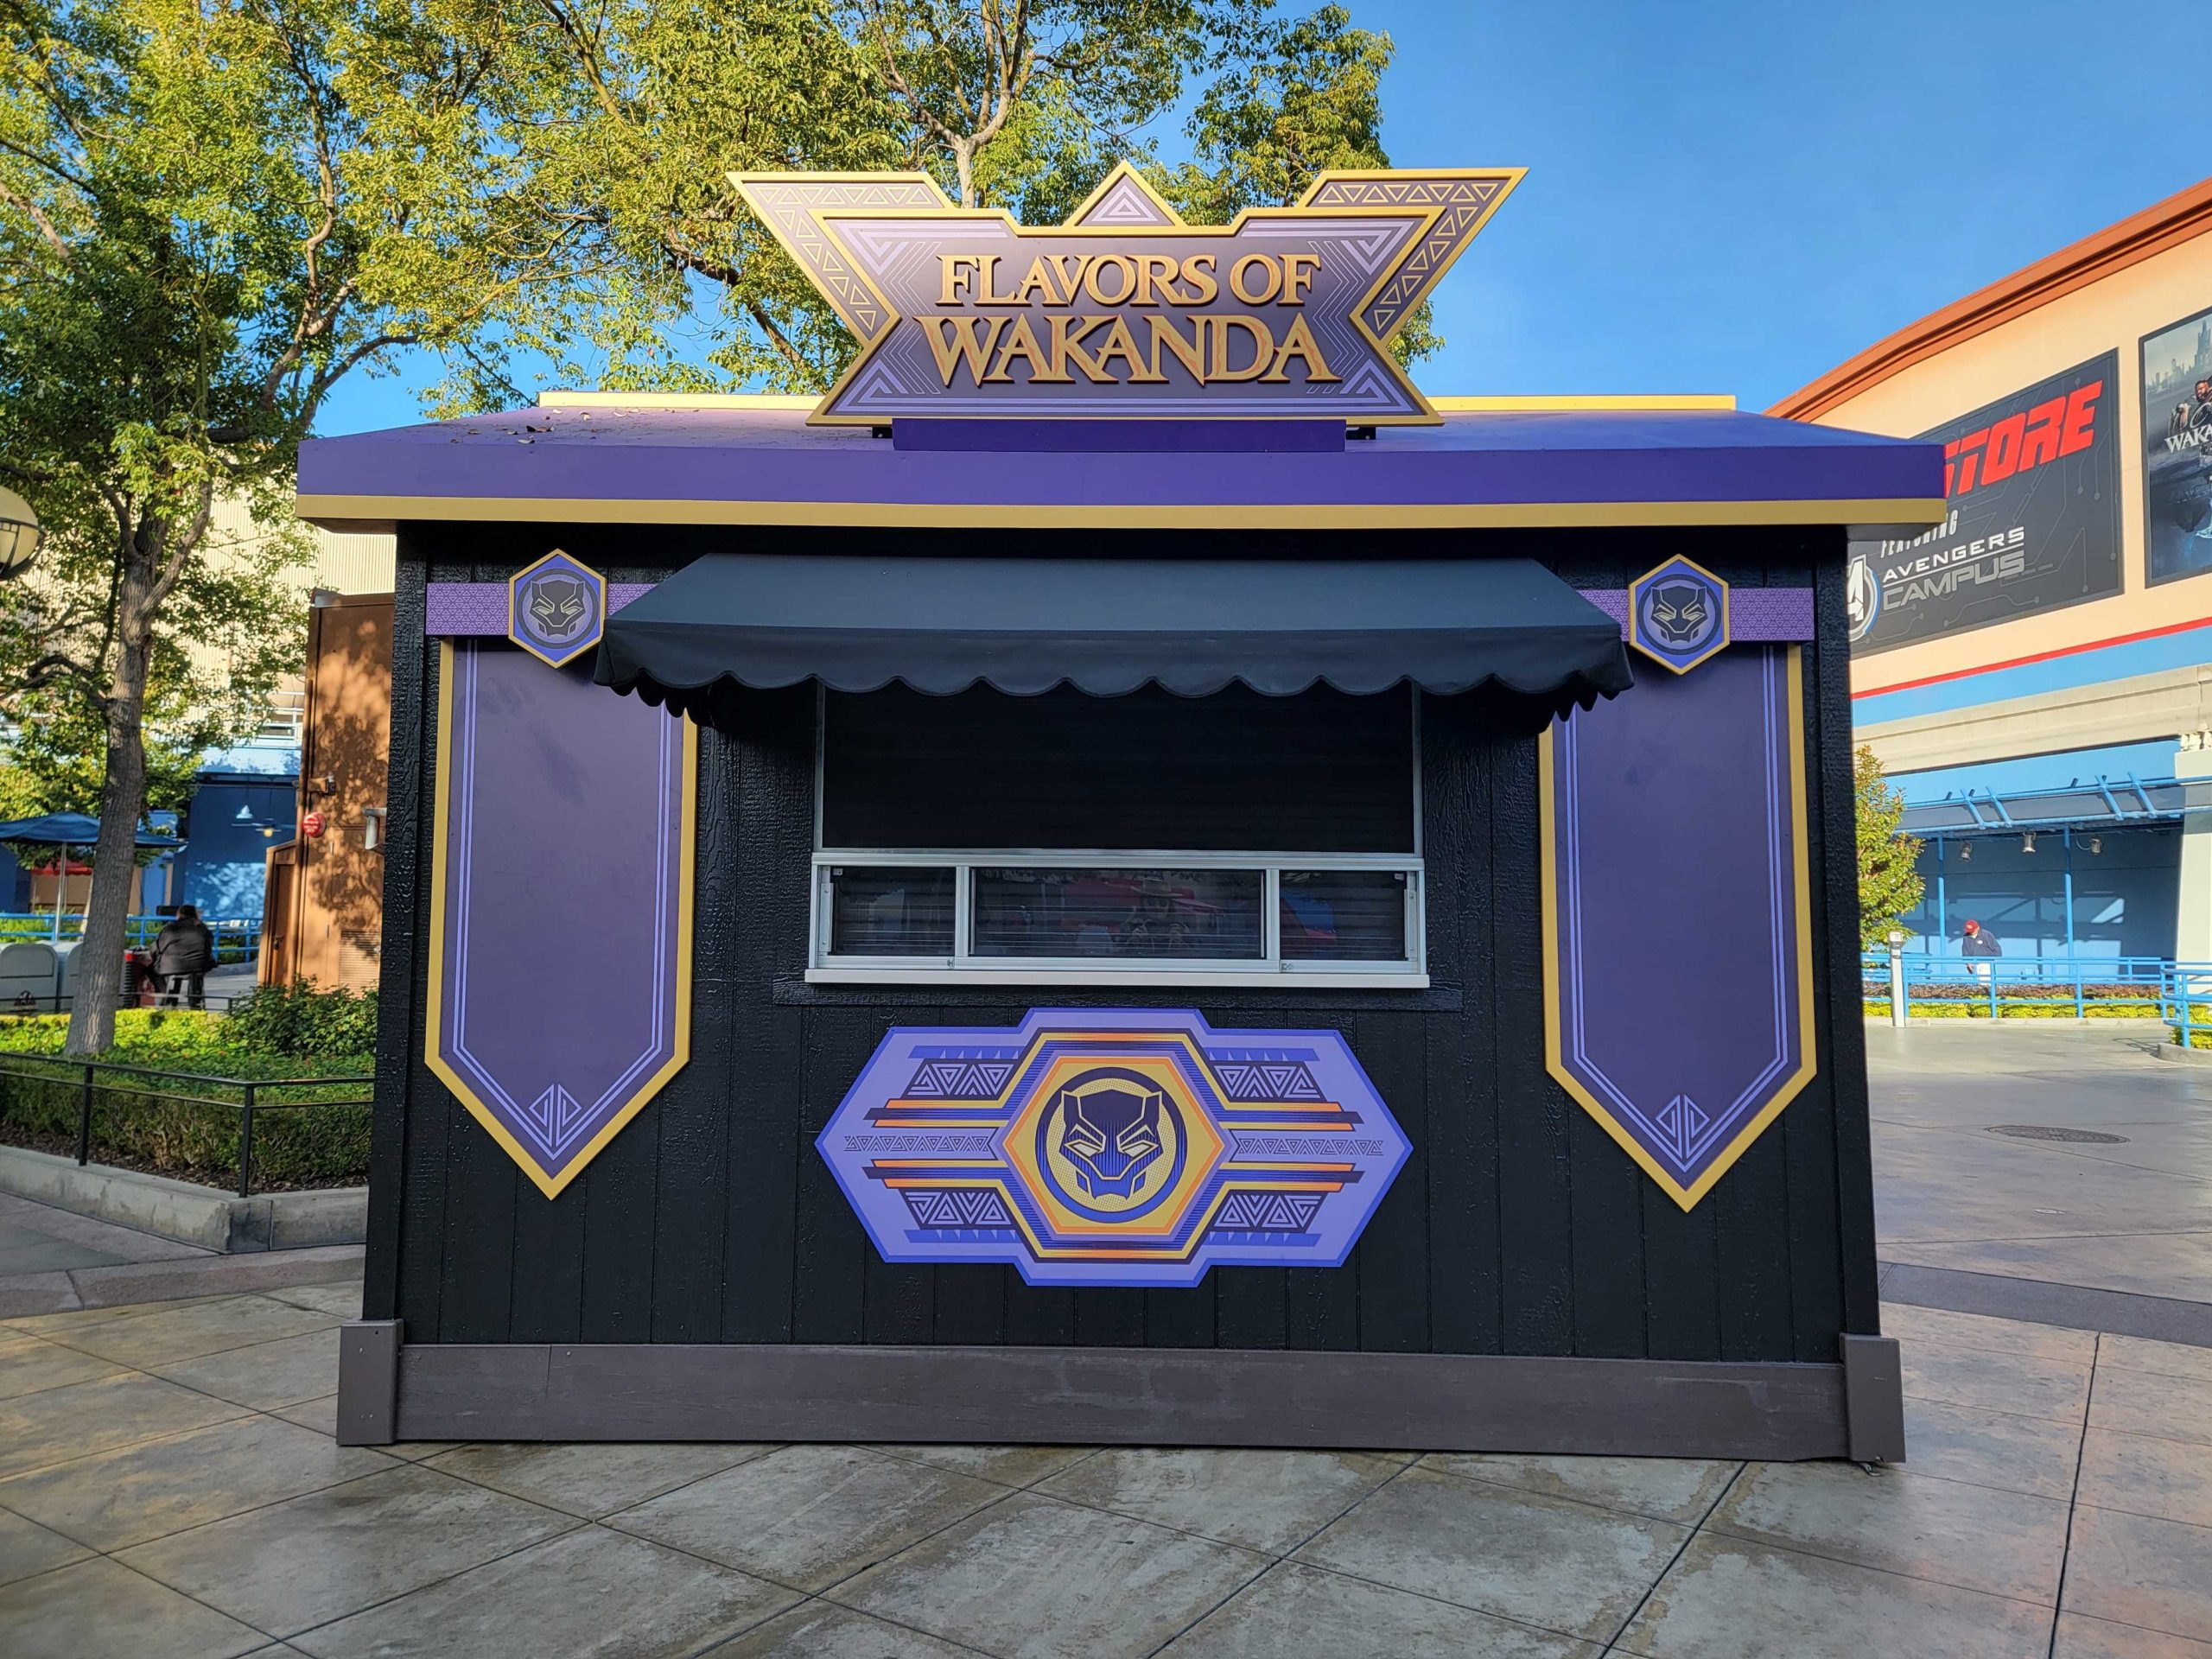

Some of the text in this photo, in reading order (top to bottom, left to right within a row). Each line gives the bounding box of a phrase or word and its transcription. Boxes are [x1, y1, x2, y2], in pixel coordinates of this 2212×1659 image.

[936, 253, 1322, 307] FLAVORS OF
[912, 312, 1344, 387] WAKANDA
[1883, 526, 2024, 583] AVENGERS
[1883, 550, 2024, 611] CAMPUS
